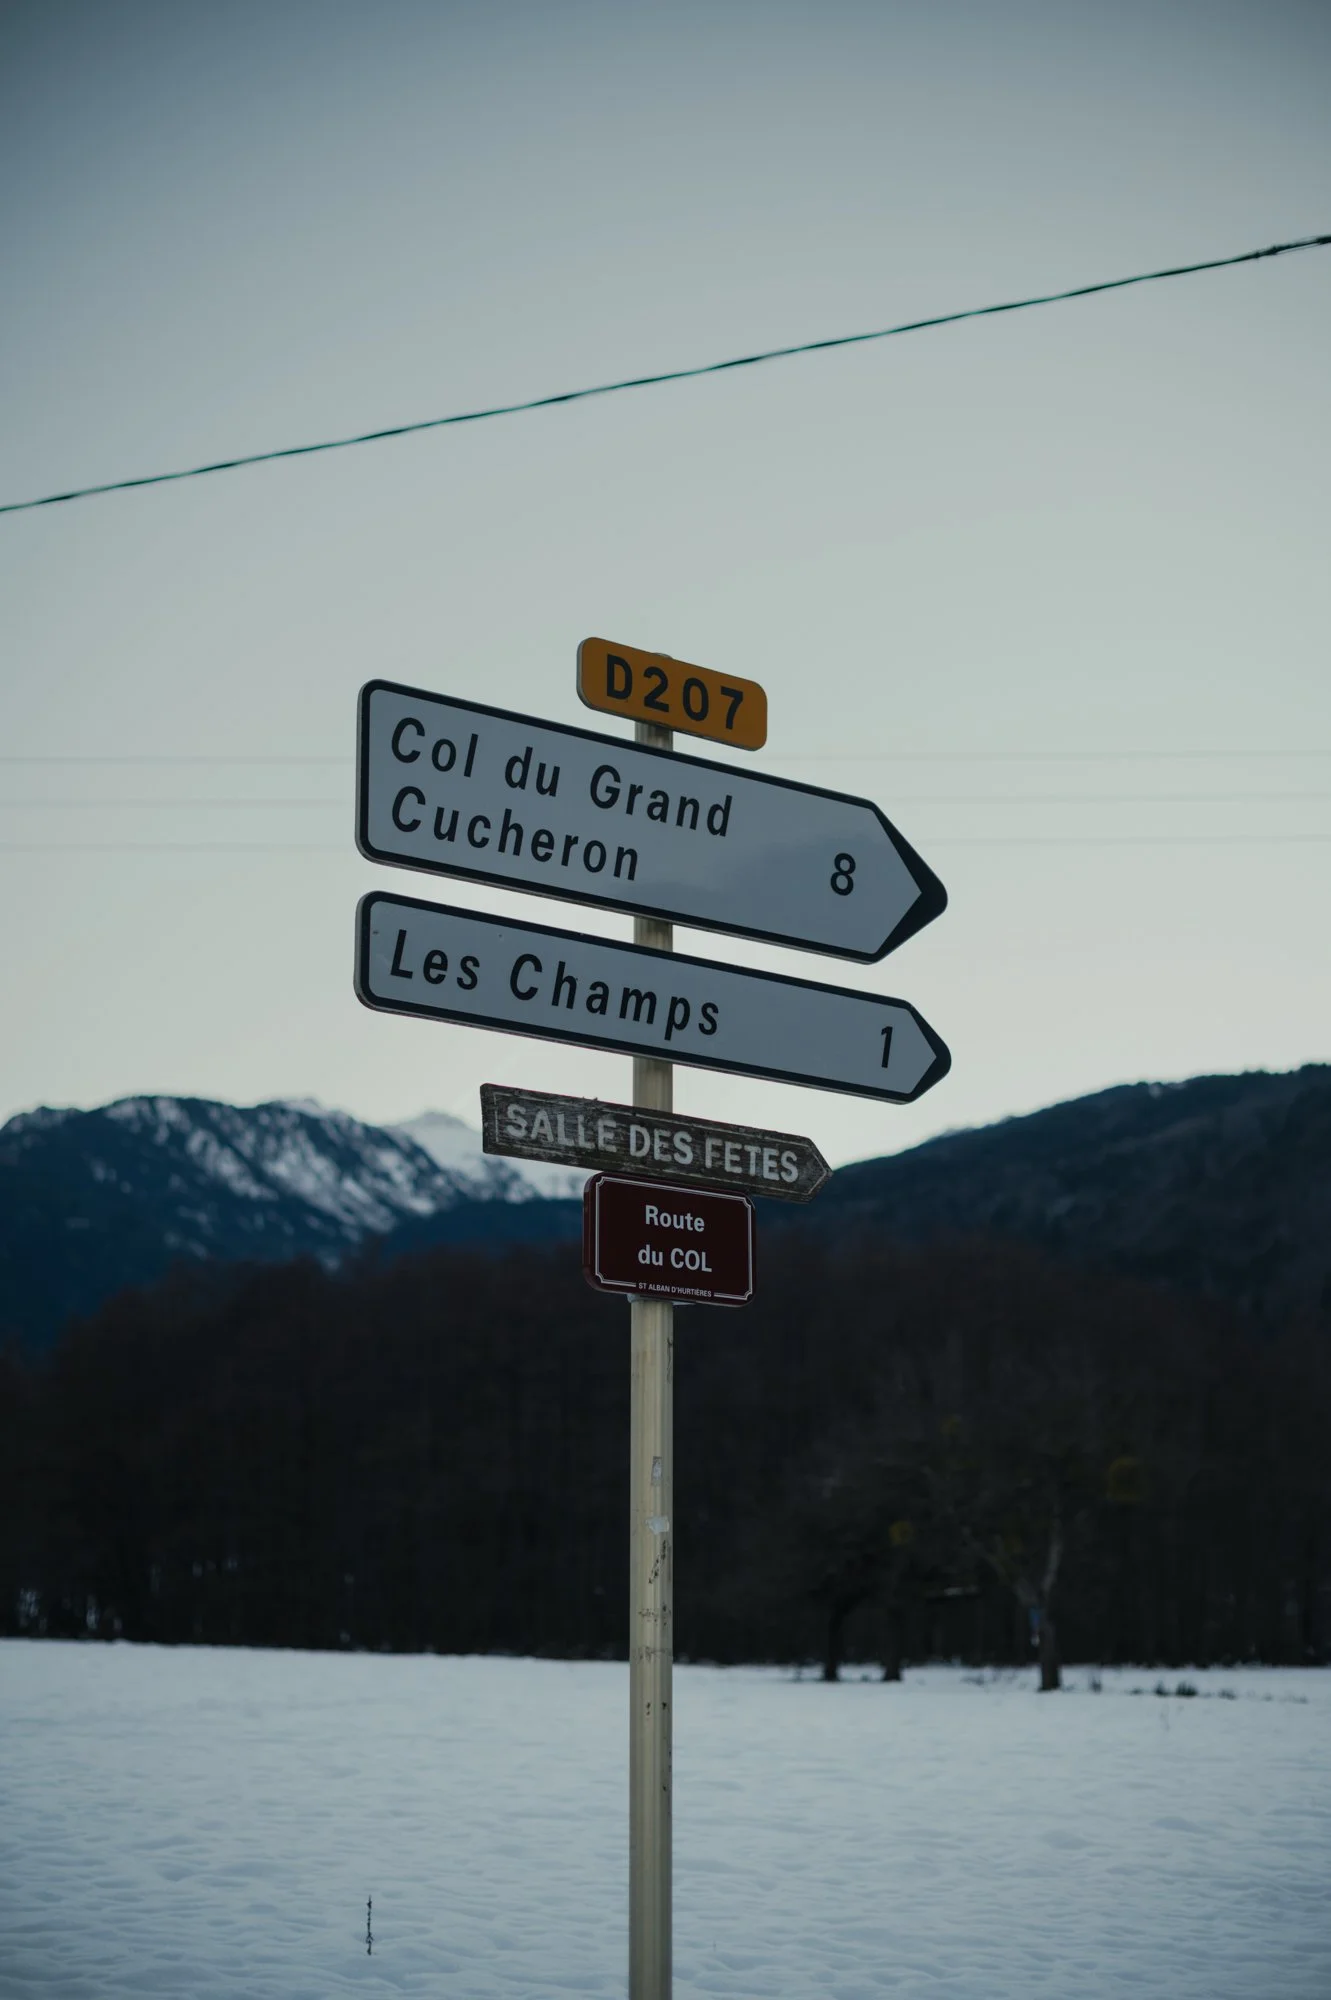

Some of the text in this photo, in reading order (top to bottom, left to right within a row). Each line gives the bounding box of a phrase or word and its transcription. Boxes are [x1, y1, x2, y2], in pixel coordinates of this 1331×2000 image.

[606, 654, 744, 731] D207
[390, 717, 732, 837] Col du Grand
[390, 785, 639, 881] Cucheron
[830, 852, 856, 896] 8
[390, 929, 893, 1069] Les Champs 1
[505, 1103, 800, 1183] SALLE DES FETES
[645, 1204, 705, 1232] Route
[638, 1244, 712, 1273] du COL
[638, 1282, 647, 1290] ST
[648, 1283, 670, 1292] ALBAN
